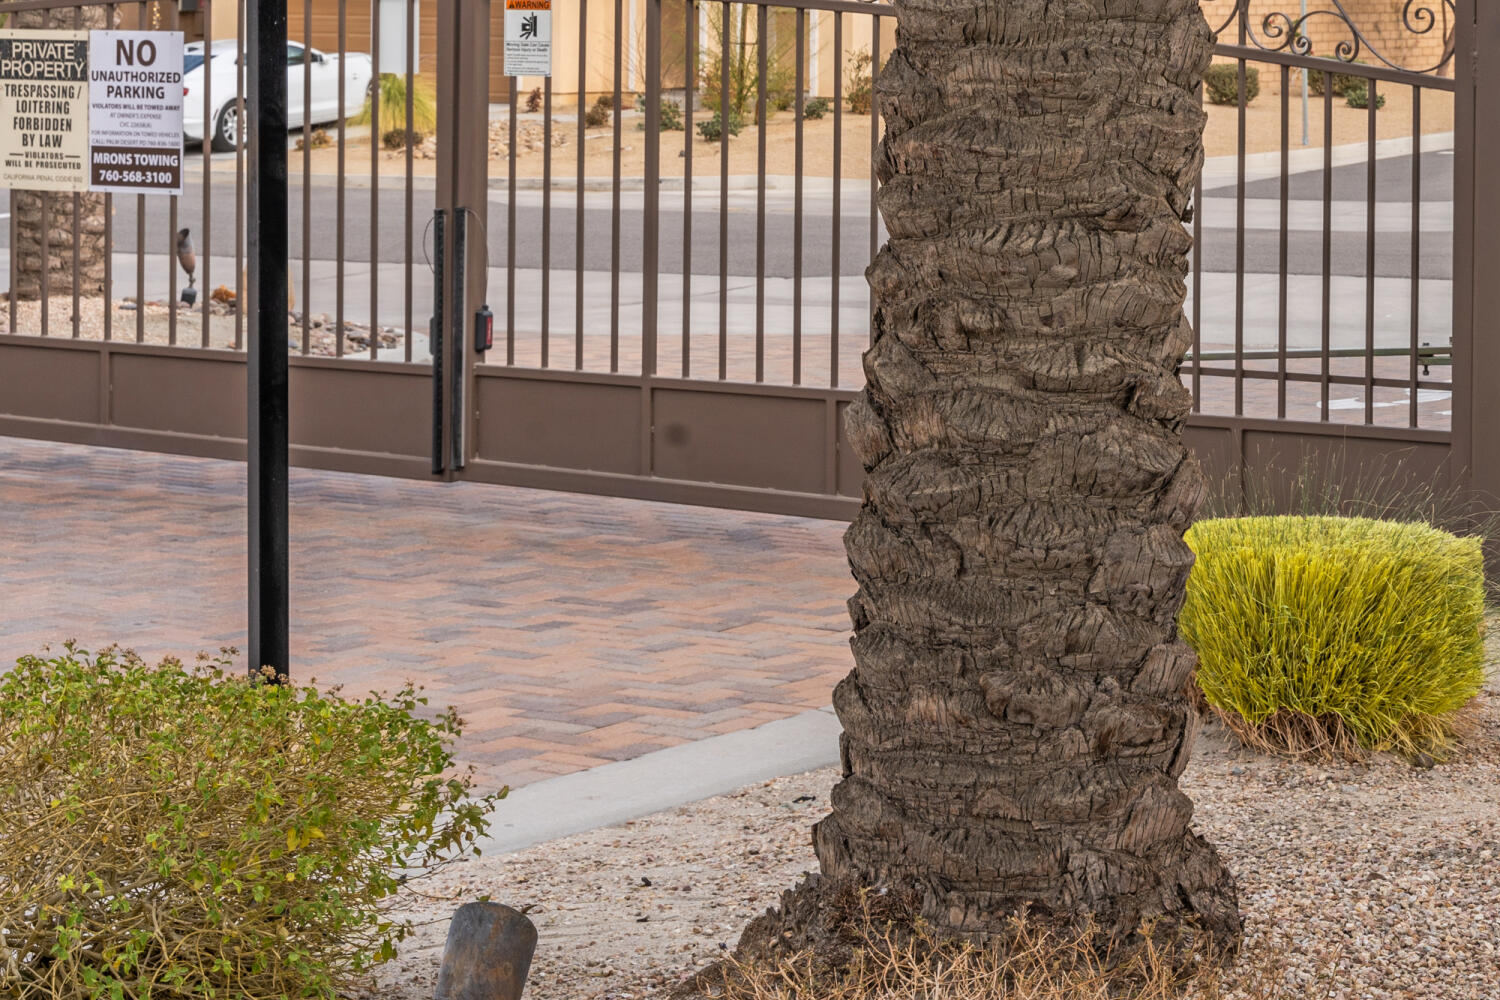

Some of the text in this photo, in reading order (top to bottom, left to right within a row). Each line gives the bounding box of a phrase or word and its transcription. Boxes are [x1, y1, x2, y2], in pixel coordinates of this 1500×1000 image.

[516, 0, 550, 9] WARNING
[12, 42, 75, 59] PRIVATE
[116, 39, 157, 67] NO
[1, 60, 85, 78] PROPERTY
[91, 70, 182, 84] UNAUTHORIZED
[5, 83, 75, 99] TRESPASSING
[106, 85, 165, 100] PARKING
[16, 100, 70, 115] LOITERING
[13, 116, 72, 132] FORBIDDEN
[22, 133, 63, 148] BY LAW
[25, 151, 64, 160] VIOLATORS
[93, 152, 178, 167] MRONS TOWING
[5, 160, 82, 170] WILL BE PROSECUTED
[99, 169, 172, 184] 760-568-3100
